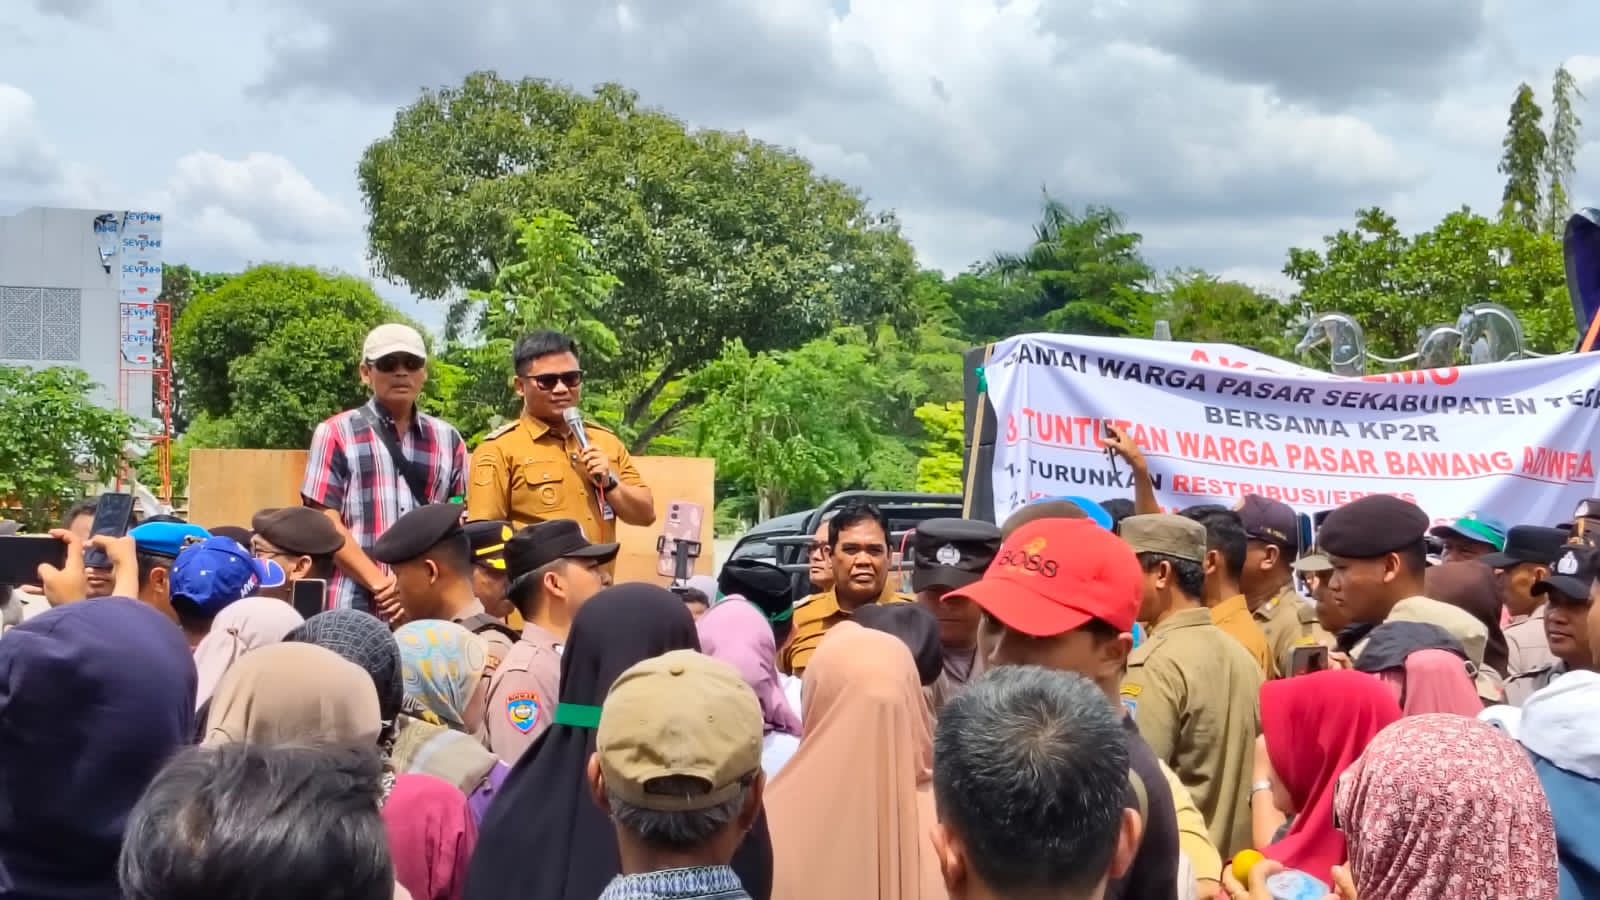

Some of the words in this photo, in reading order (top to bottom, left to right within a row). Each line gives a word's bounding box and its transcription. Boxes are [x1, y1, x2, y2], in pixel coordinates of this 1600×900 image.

[1097, 357, 1206, 392] WARGA
[1216, 373, 1316, 404] PASAR
[1322, 389, 1537, 415] SEKABUPATEN
[1204, 406, 1350, 438] BERSAMA
[1358, 421, 1440, 443] KP2R
[1175, 431, 1279, 469] WARGA
[1286, 443, 1379, 475] PASAR
[1384, 450, 1513, 476] BAWANG
